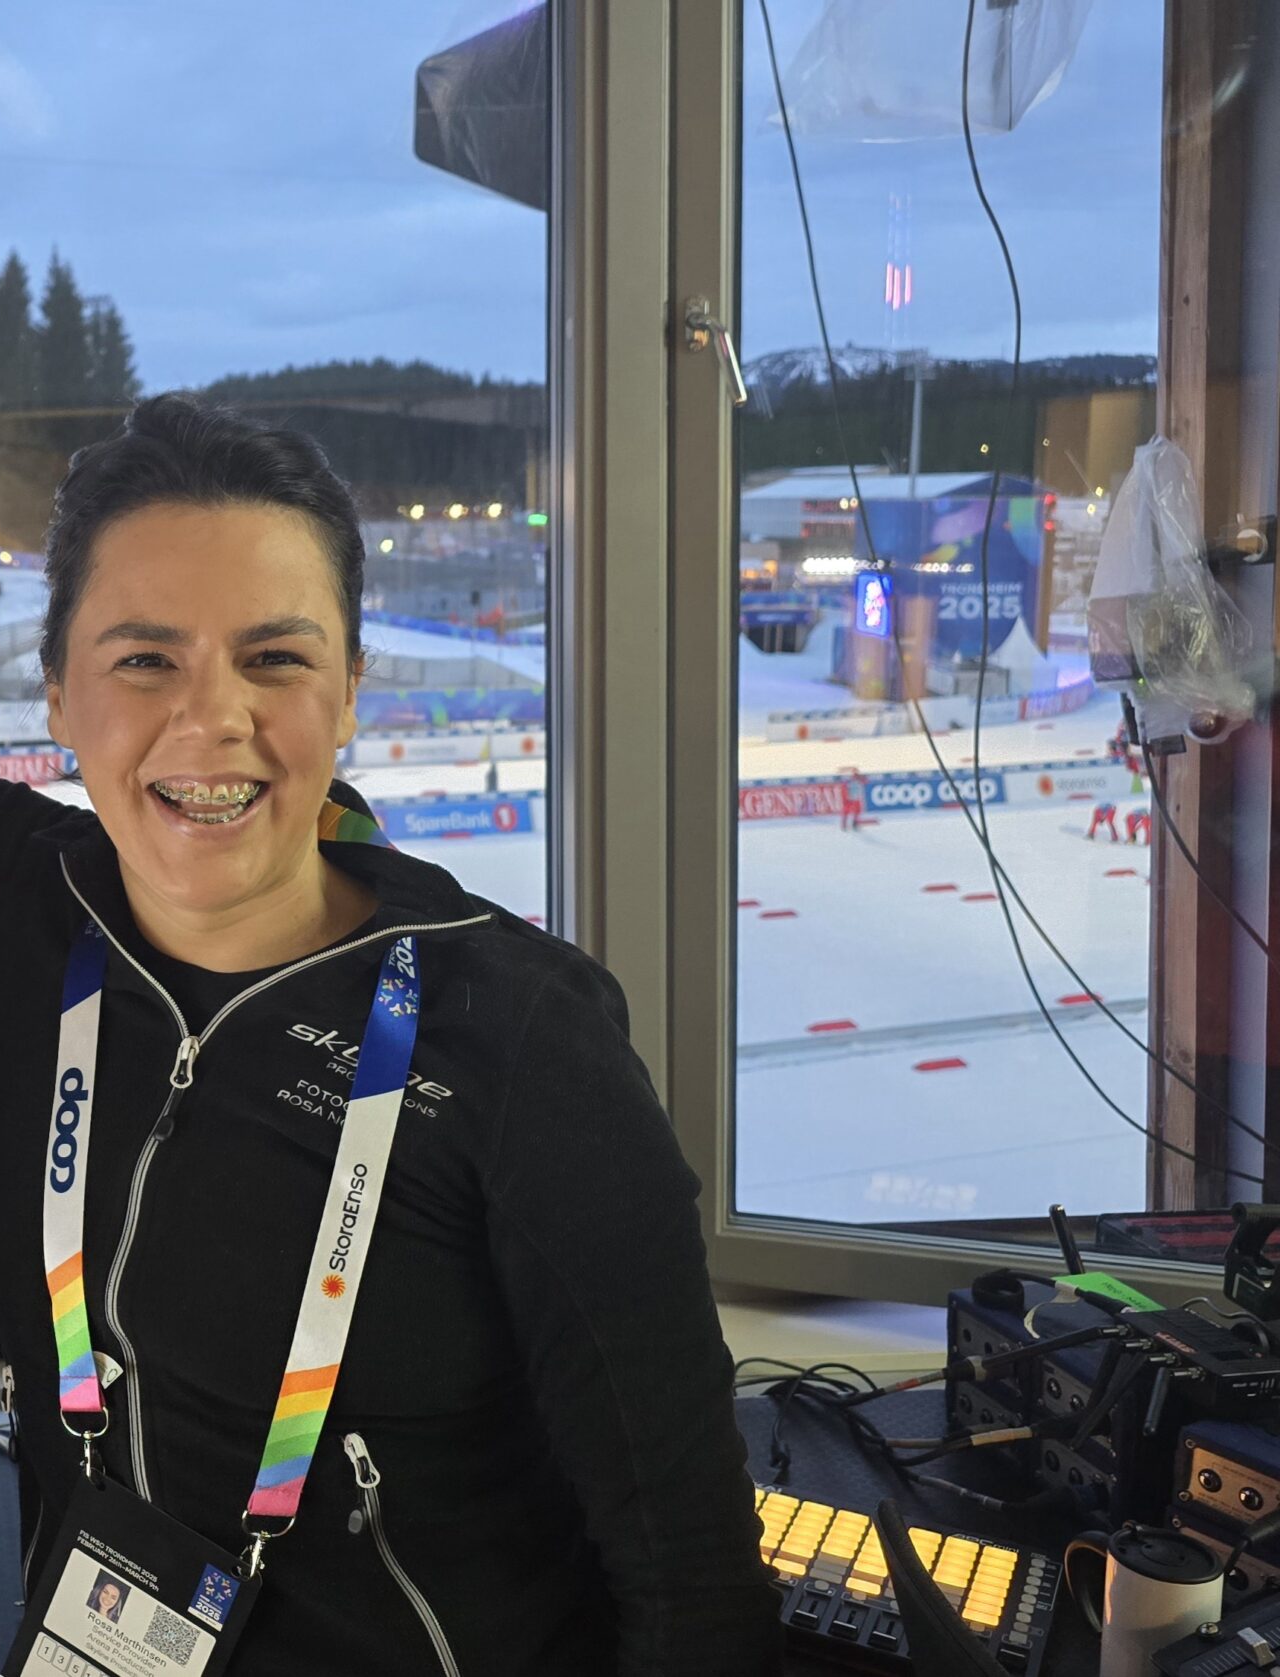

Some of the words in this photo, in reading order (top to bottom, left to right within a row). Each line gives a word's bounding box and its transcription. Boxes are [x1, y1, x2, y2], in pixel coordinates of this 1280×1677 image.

[938, 595, 1021, 620] 2025
[870, 783, 933, 809] coop
[404, 811, 491, 832] SpareBank
[276, 1089, 324, 1117] ROSA
[49, 1066, 89, 1194] coop
[328, 1162, 369, 1273] StoraEnso
[105, 1545, 142, 1571] TRONDHEIM
[195, 1601, 220, 1620] 2025
[87, 1611, 112, 1632] Rosa
[114, 1629, 167, 1667] Marthinsen
[91, 1625, 122, 1648] Service
[122, 1645, 157, 1669] Provider
[86, 1632, 111, 1652] Arena
[111, 1648, 155, 1677] Production
